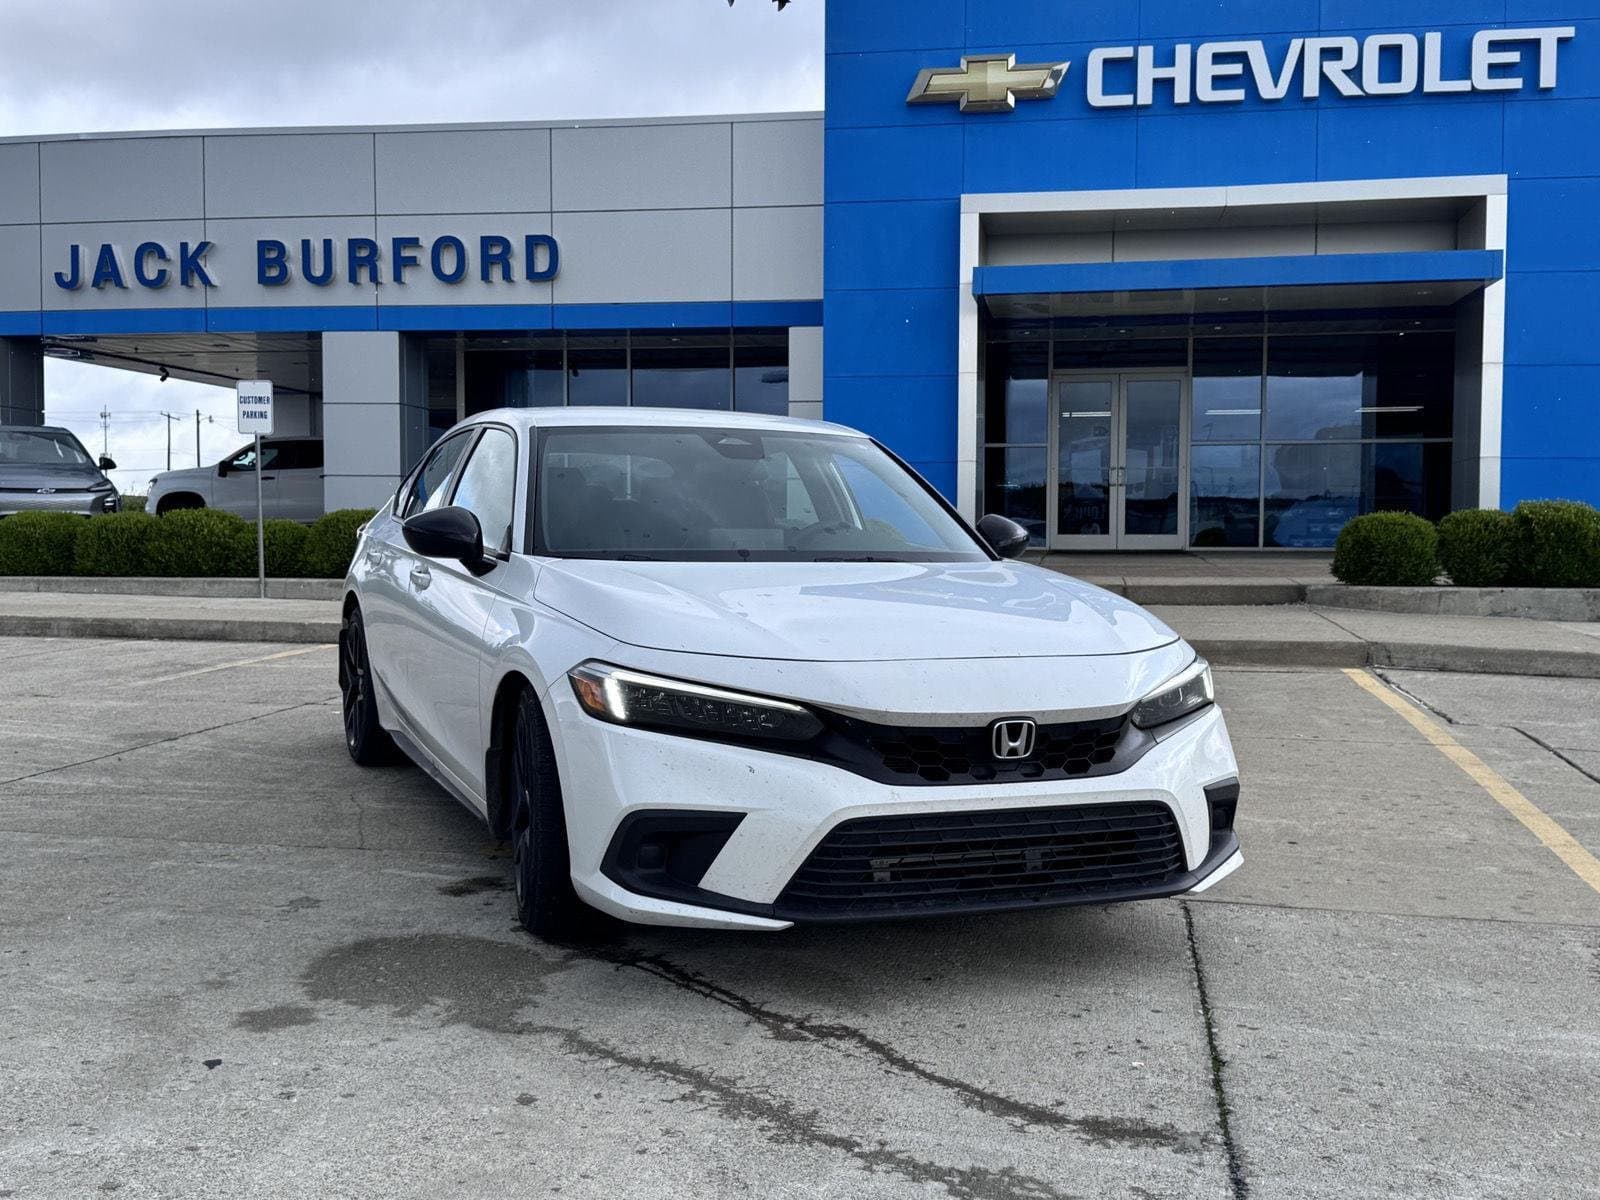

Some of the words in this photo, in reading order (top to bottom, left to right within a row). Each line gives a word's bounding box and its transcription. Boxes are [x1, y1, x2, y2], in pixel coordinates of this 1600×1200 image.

[1086, 26, 1576, 108] CHEVROLET
[54, 241, 216, 290] JACK
[257, 234, 560, 286] BURFORD
[240, 395, 270, 405] CUSTOMER
[242, 410, 268, 420] PARKING
